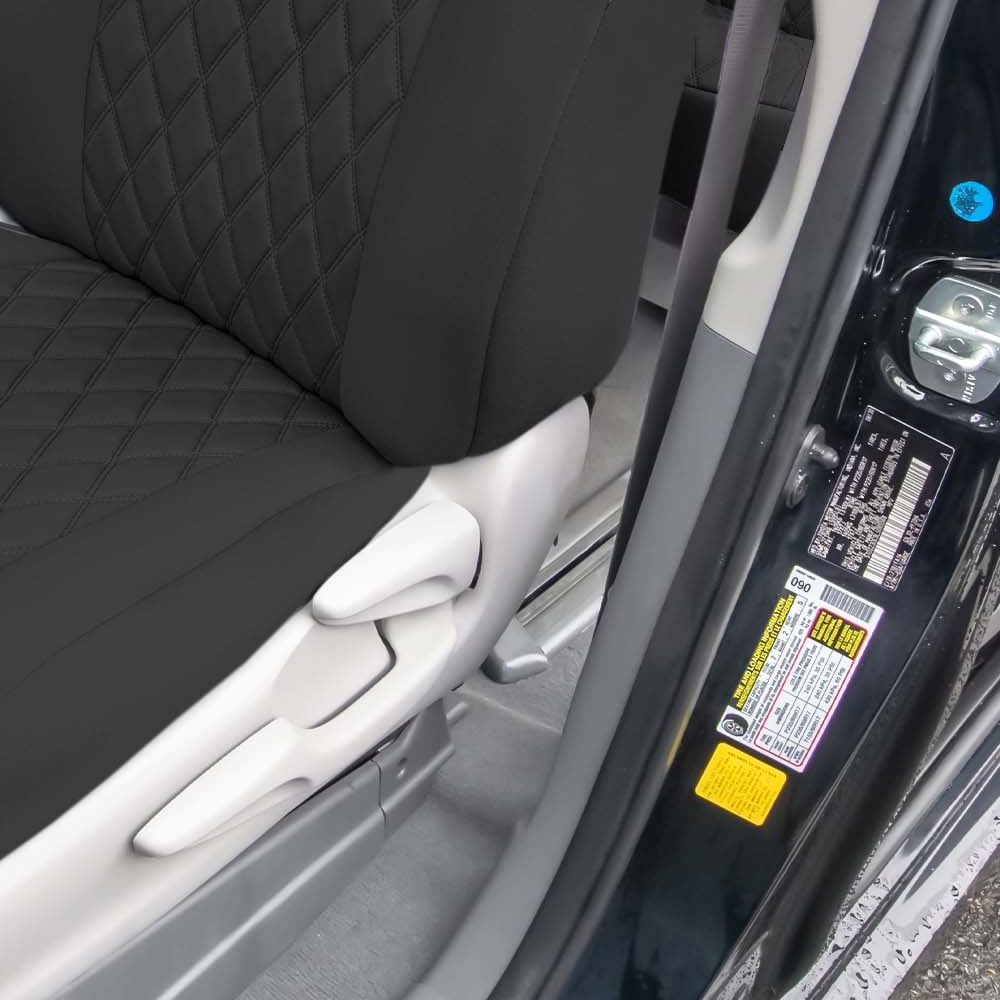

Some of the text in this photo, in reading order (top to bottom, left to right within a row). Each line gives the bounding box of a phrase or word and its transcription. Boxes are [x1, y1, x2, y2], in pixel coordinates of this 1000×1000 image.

[938, 450, 951, 461] A
[789, 575, 812, 593] 090
[732, 683, 745, 699] TIRE
[740, 669, 752, 684] AND
[760, 597, 786, 642] INFORMATION
